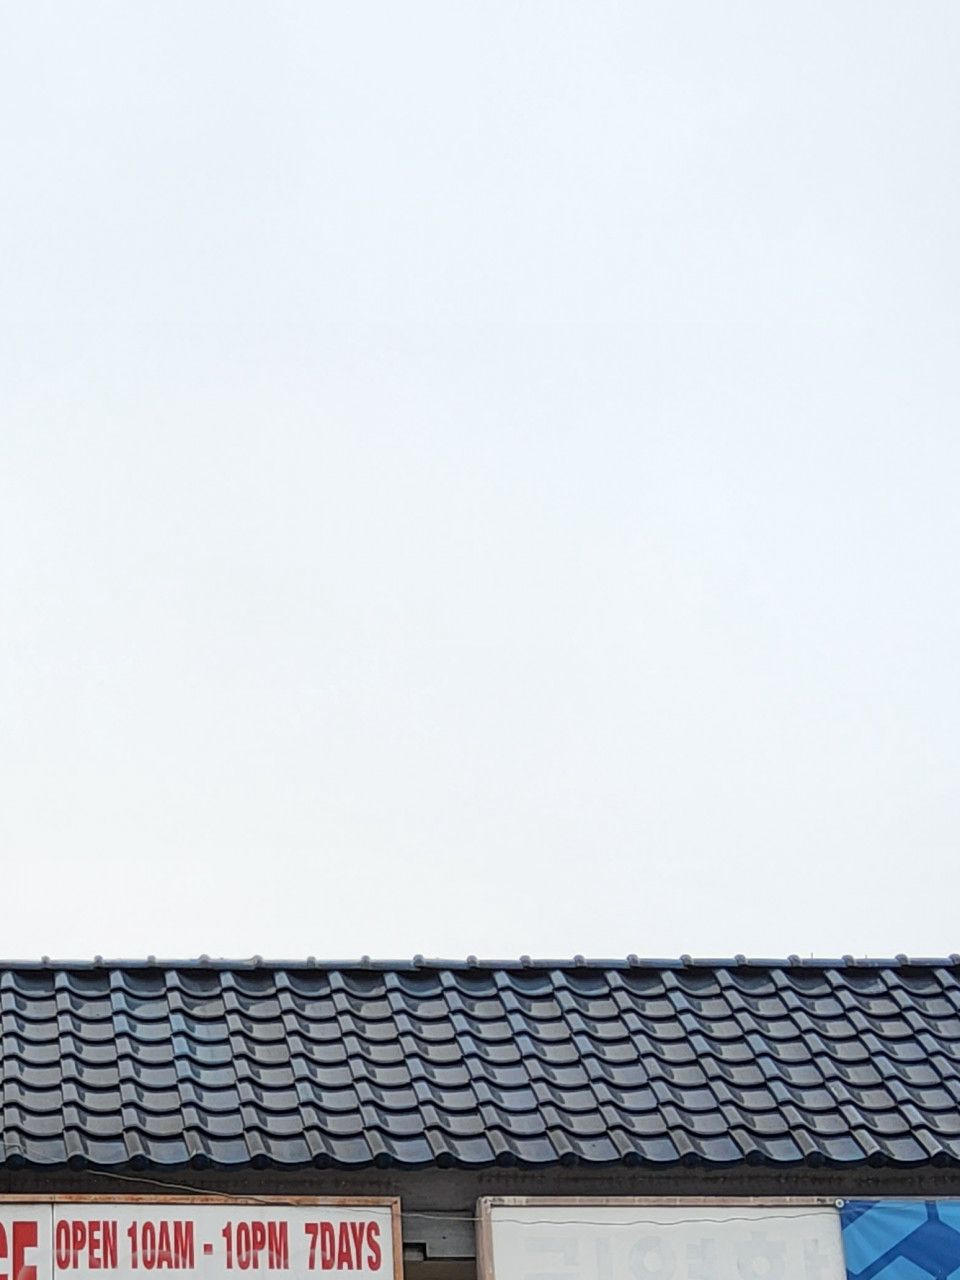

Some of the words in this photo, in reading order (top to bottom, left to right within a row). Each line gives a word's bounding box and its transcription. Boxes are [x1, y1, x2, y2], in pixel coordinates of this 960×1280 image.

[55, 1219, 118, 1270] OPEN
[127, 1220, 194, 1270] 10AM
[221, 1221, 289, 1271] 10PM
[304, 1221, 382, 1271] 7DAYS
